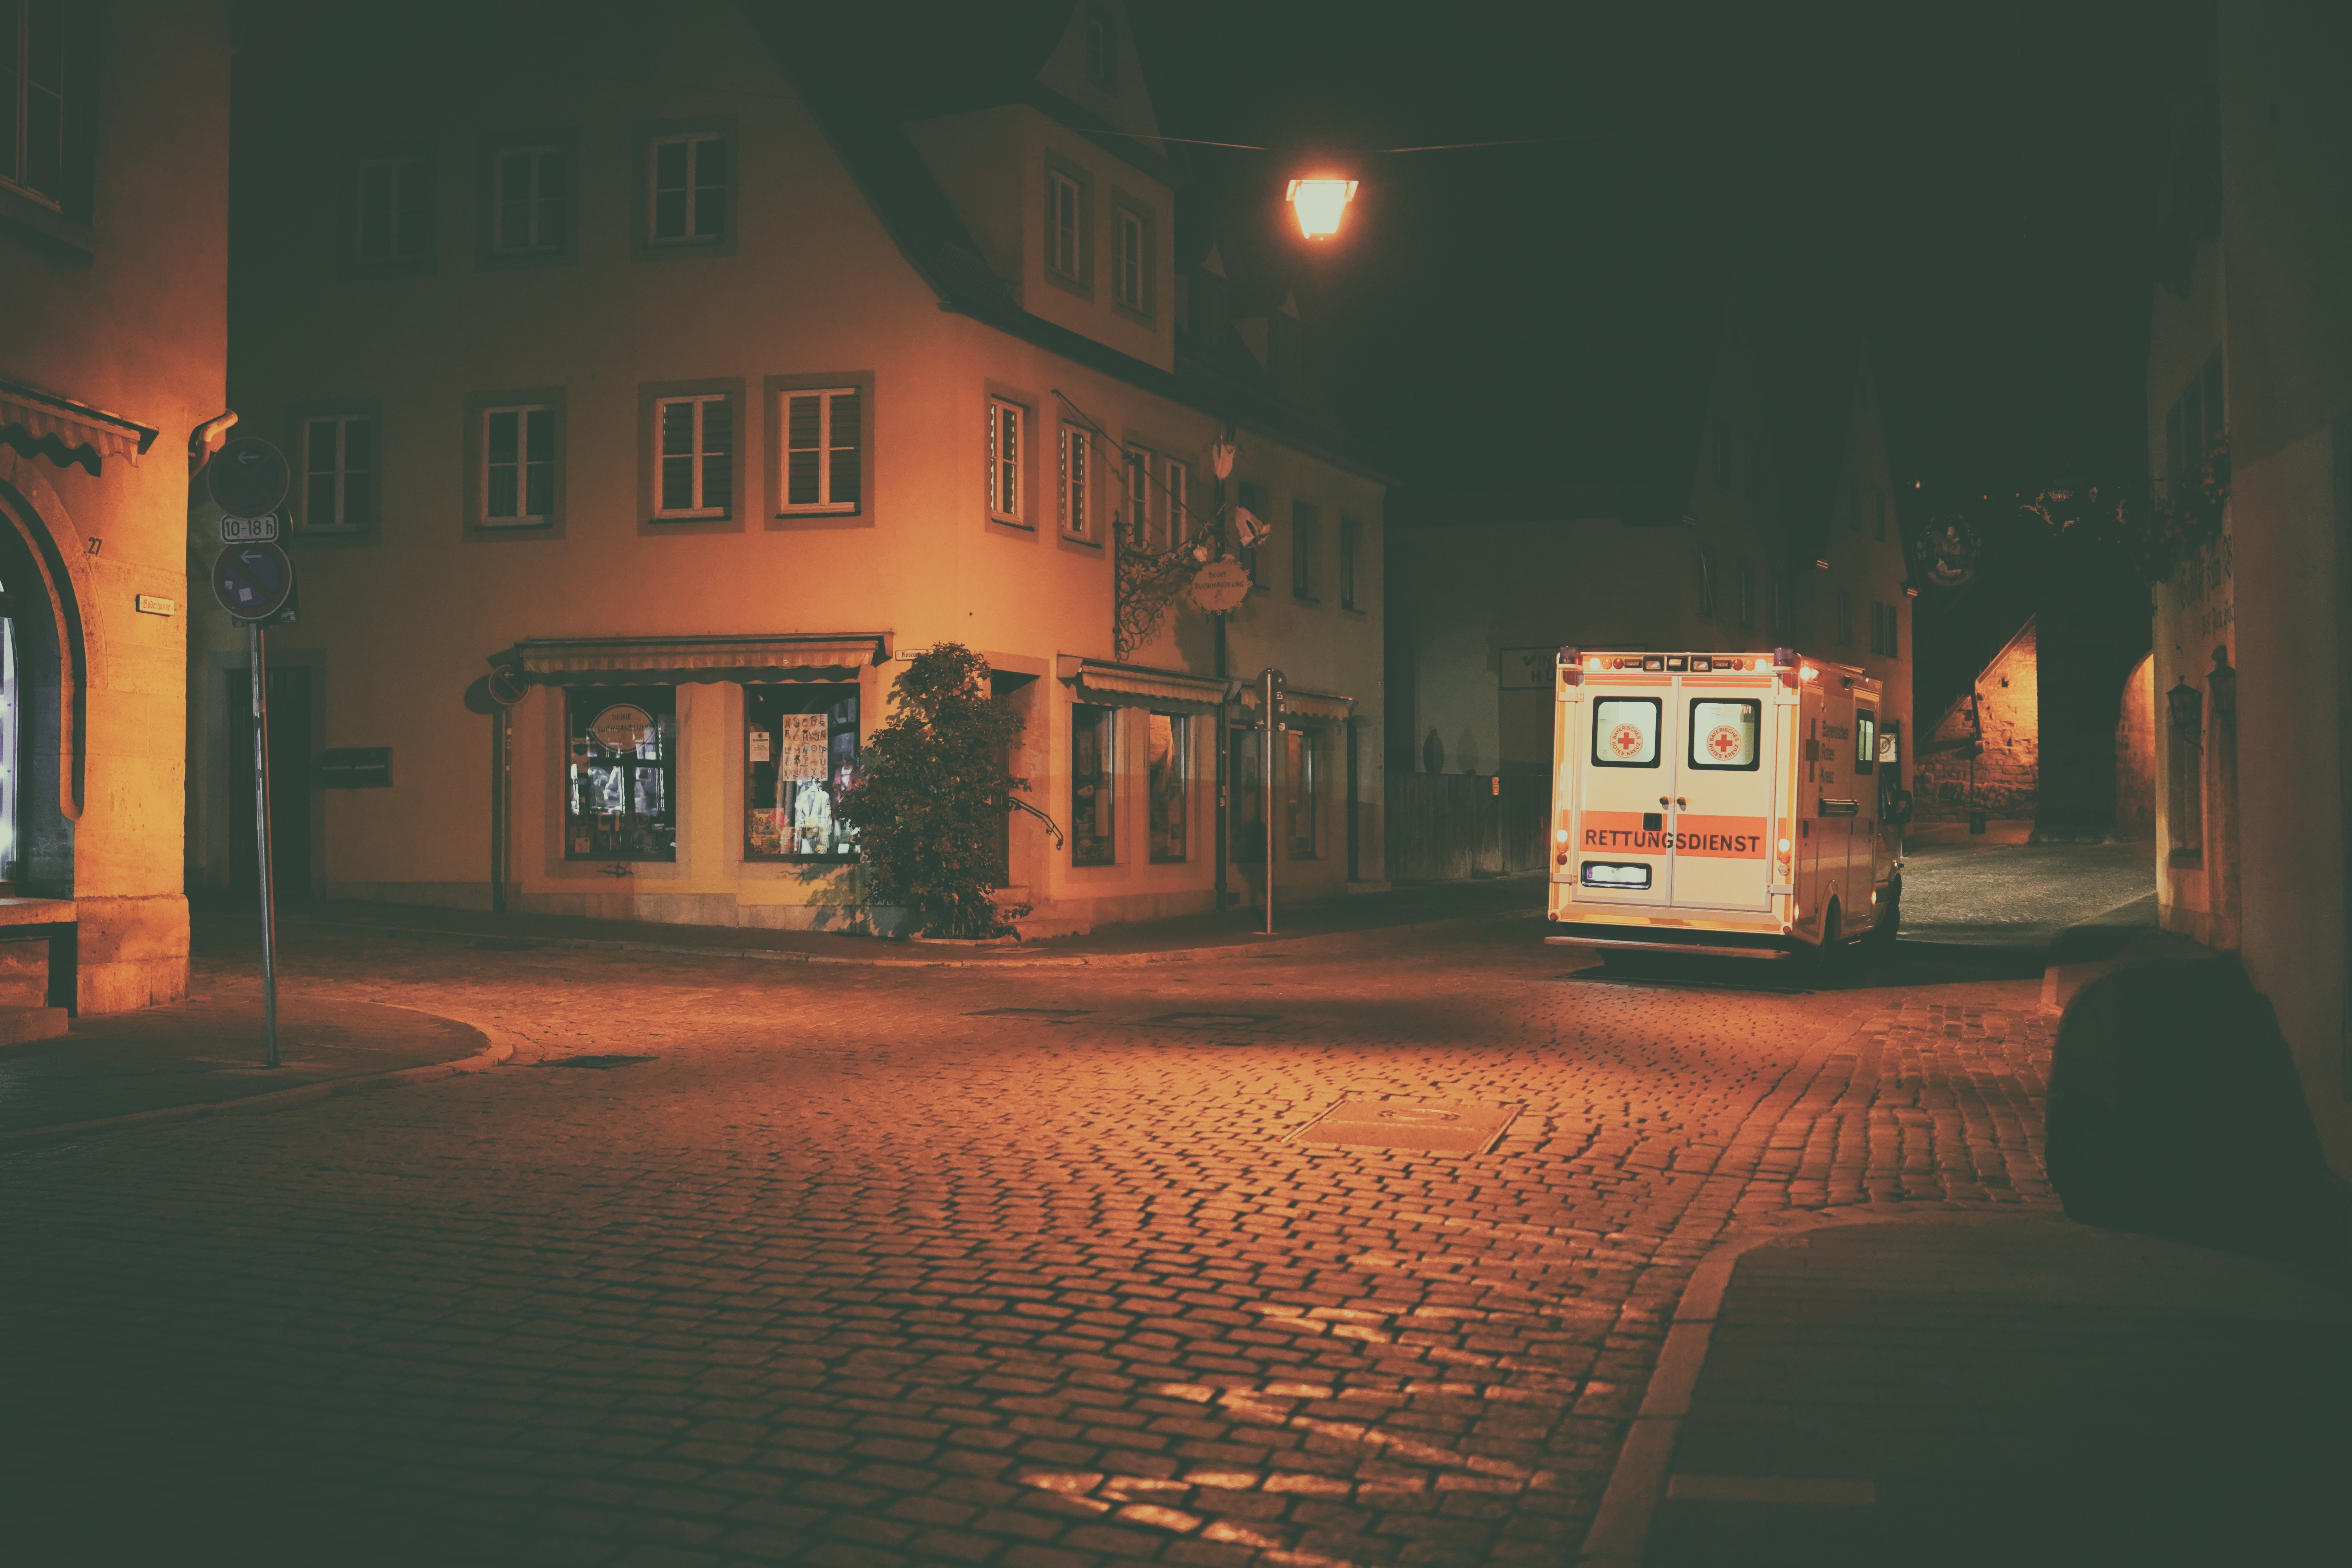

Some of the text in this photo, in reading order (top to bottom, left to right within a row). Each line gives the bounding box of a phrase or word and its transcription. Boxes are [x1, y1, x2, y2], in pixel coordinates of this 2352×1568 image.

[226, 520, 273, 536] 10-18 h
[88, 537, 102, 555] 27
[1195, 581, 1244, 590] BUCHHANDLUNG
[612, 713, 632, 721] DEINE
[1612, 726, 1641, 740] BAYERISCHES
[1710, 728, 1739, 742] BAYERISCHES
[1612, 741, 1641, 756] ROTES KREUZ
[1709, 744, 1739, 758] ROTES KREUZ
[1586, 829, 1760, 852] RETTUNGSDIENST
